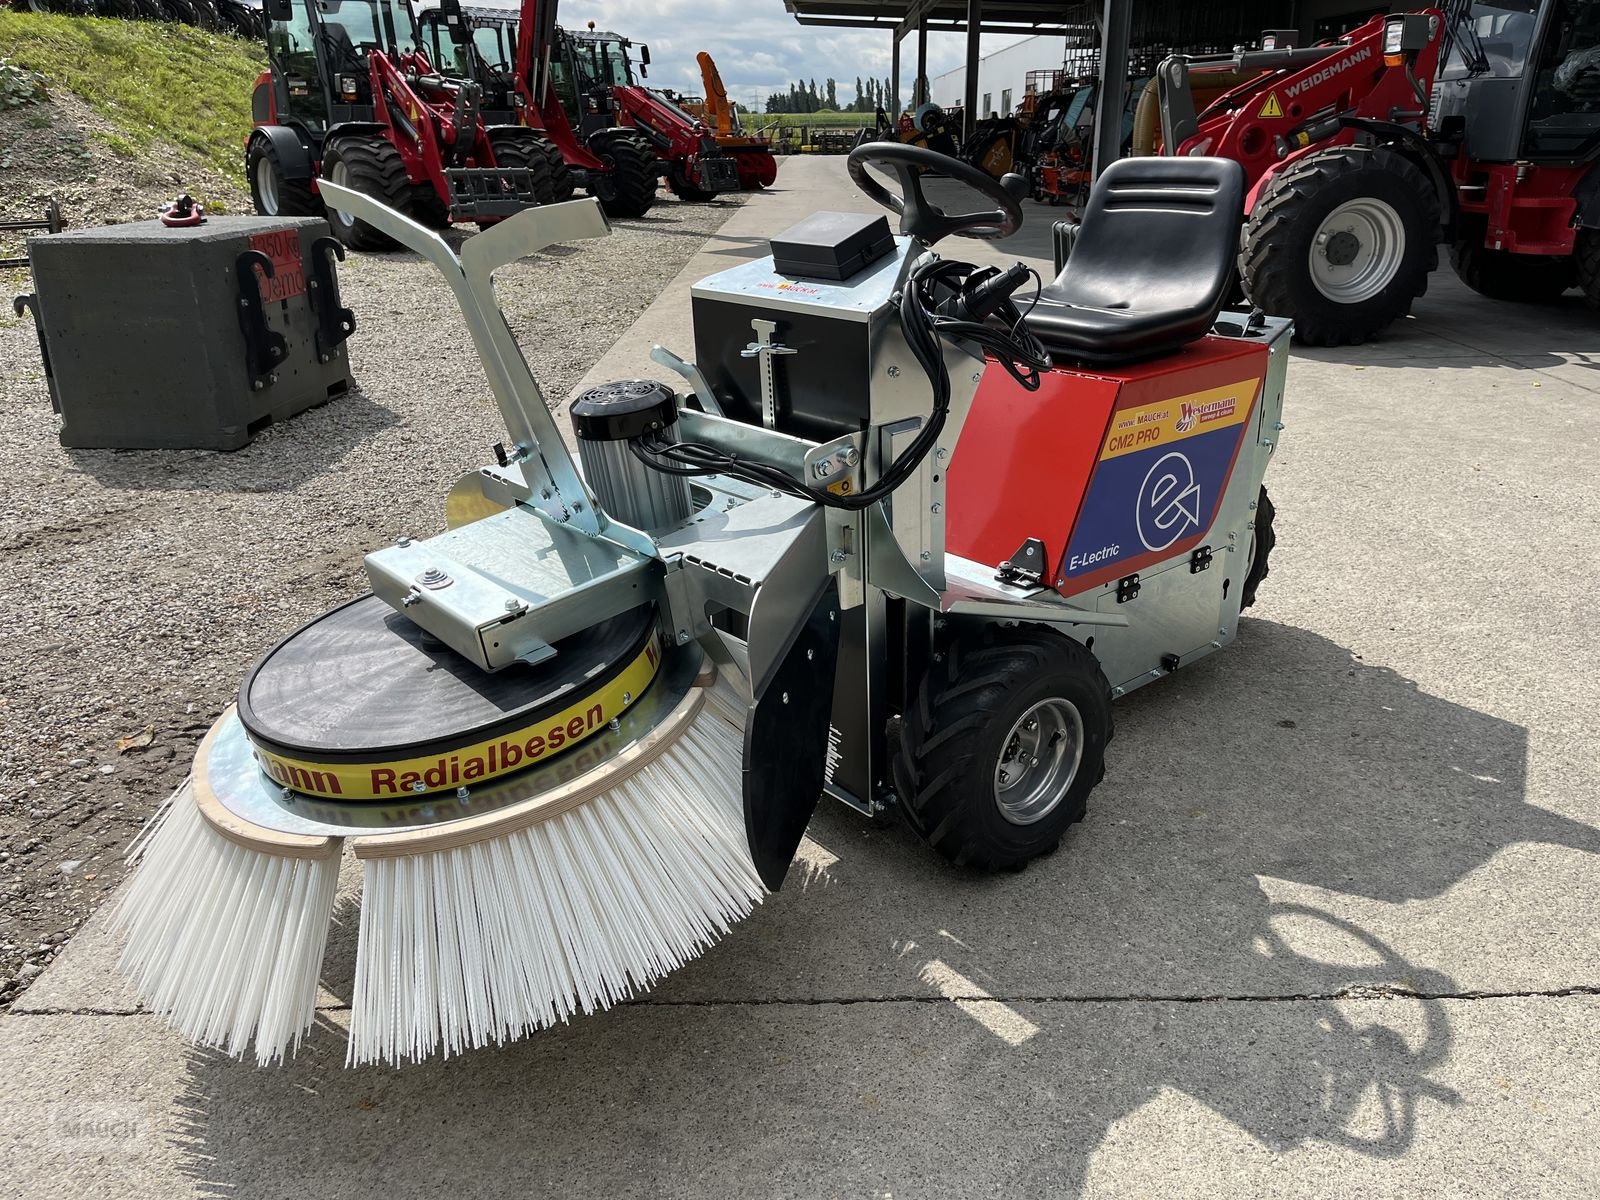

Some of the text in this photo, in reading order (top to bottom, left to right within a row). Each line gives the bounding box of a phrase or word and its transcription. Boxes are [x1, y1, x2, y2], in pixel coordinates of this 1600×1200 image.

[1285, 46, 1371, 98] WEIDEMANN
[1181, 397, 1236, 421] Westermann
[1109, 426, 1160, 452] CM2 PRO
[1069, 543, 1120, 571] E-Lectric
[371, 703, 603, 795] Radialbesen
